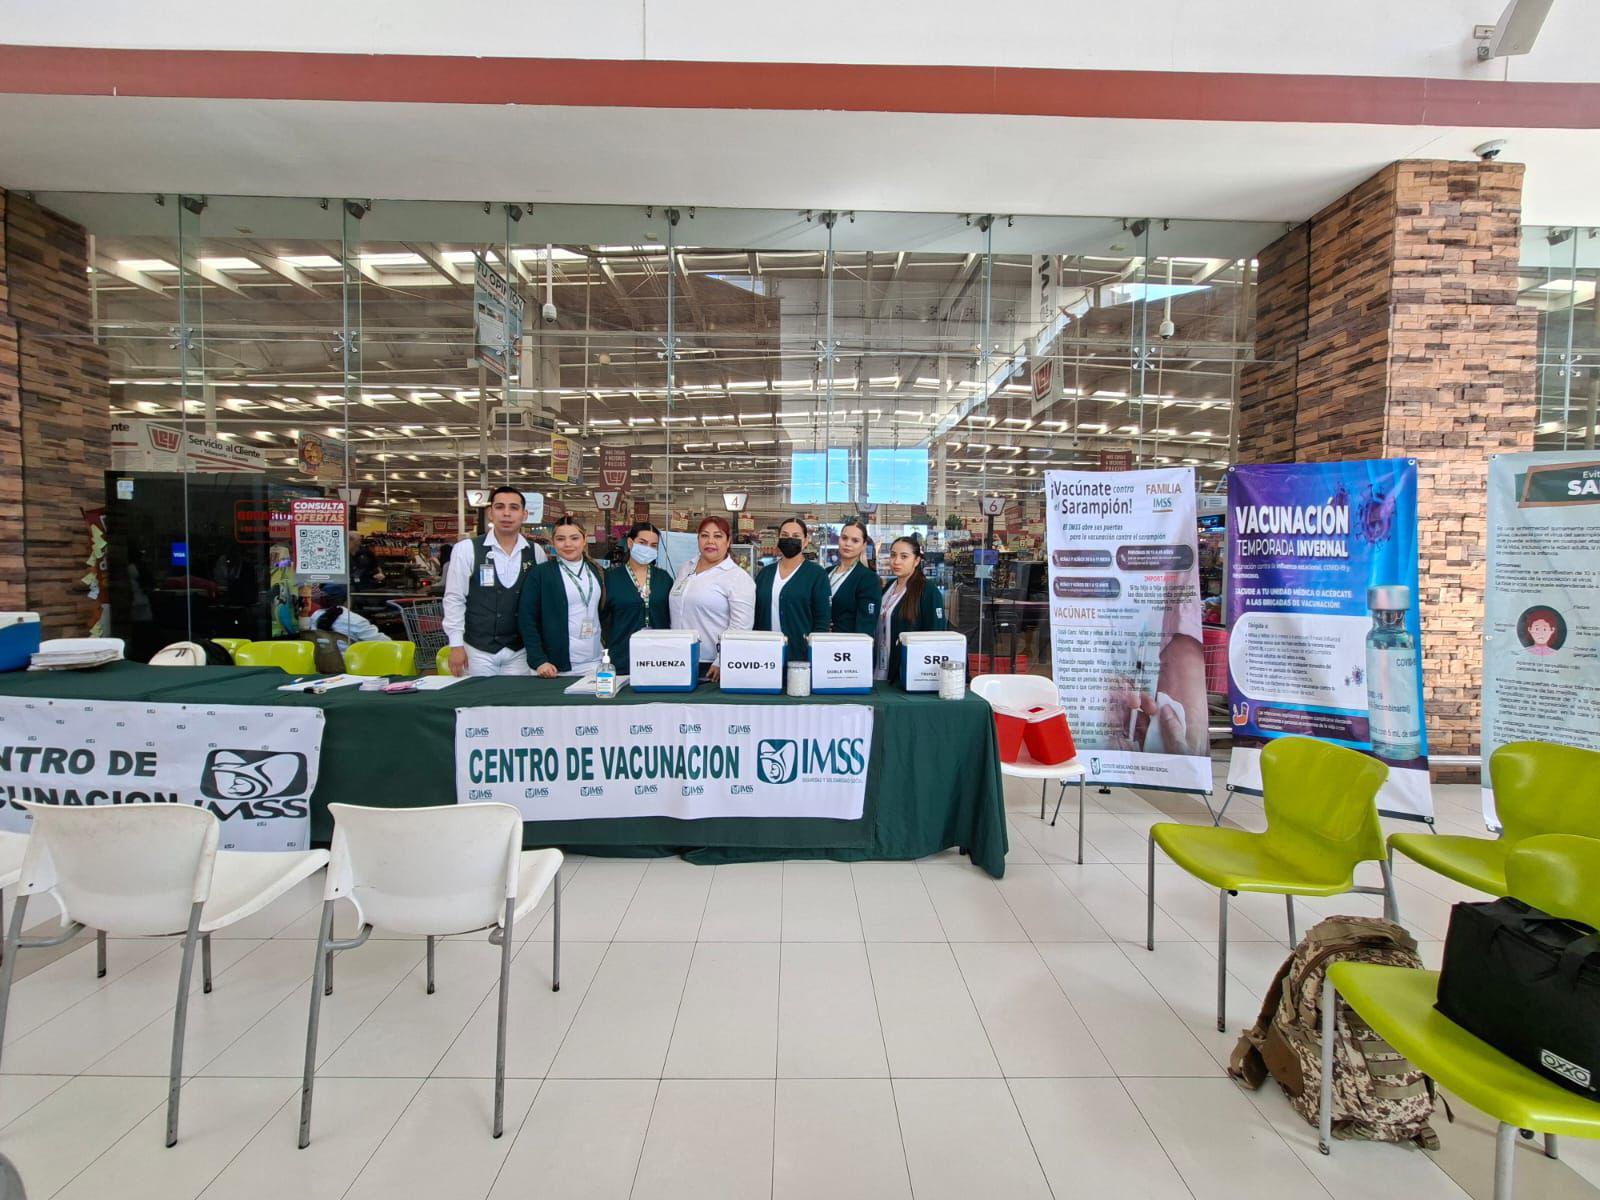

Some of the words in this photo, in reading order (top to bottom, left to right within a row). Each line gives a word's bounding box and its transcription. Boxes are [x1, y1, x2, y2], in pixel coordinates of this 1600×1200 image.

[188, 434, 223, 450] Servicio
[225, 445, 233, 453] al
[234, 445, 260, 458] Cliente
[1050, 480, 1112, 499] ¡Vacúnate
[1113, 485, 1134, 494] contra
[1146, 482, 1182, 495] FAMILIA
[1568, 479, 1600, 496] SA
[474, 492, 484, 504] 2
[602, 494, 610, 506] 3
[731, 496, 739, 508] 4
[1153, 498, 1172, 508] IMSS
[294, 502, 344, 510] CONSULTA
[990, 500, 998, 512] 6
[1062, 499, 1133, 519] Sarampión!
[294, 514, 344, 522] OFERTAS
[1236, 497, 1349, 534] VACUNACIÓN
[1236, 539, 1295, 556] TEMPORADA
[1296, 540, 1349, 558] INVERNAL
[1053, 605, 1096, 620] VACÚNATE
[834, 652, 852, 662] SR
[727, 661, 776, 670] COVID-19
[474, 727, 490, 736] IMSS
[530, 726, 545, 736] IMSS
[584, 726, 599, 734] IMSS
[639, 724, 654, 734] IMSS
[688, 724, 702, 732] IMSS
[737, 724, 752, 733] IMSS
[802, 738, 865, 776] IMSS
[108, 750, 157, 777] DE
[469, 748, 560, 784] CENTRO
[566, 746, 594, 781] DE
[600, 745, 740, 780] VACUNACION
[478, 790, 493, 798] IMSS
[534, 788, 549, 796] IMSS
[589, 786, 604, 795] IMSS
[644, 784, 658, 794] IMSS
[690, 785, 704, 794] IMSS
[740, 784, 754, 794] IMSS
[194, 798, 308, 821] MSS
[1543, 1053, 1589, 1083] OXXO
